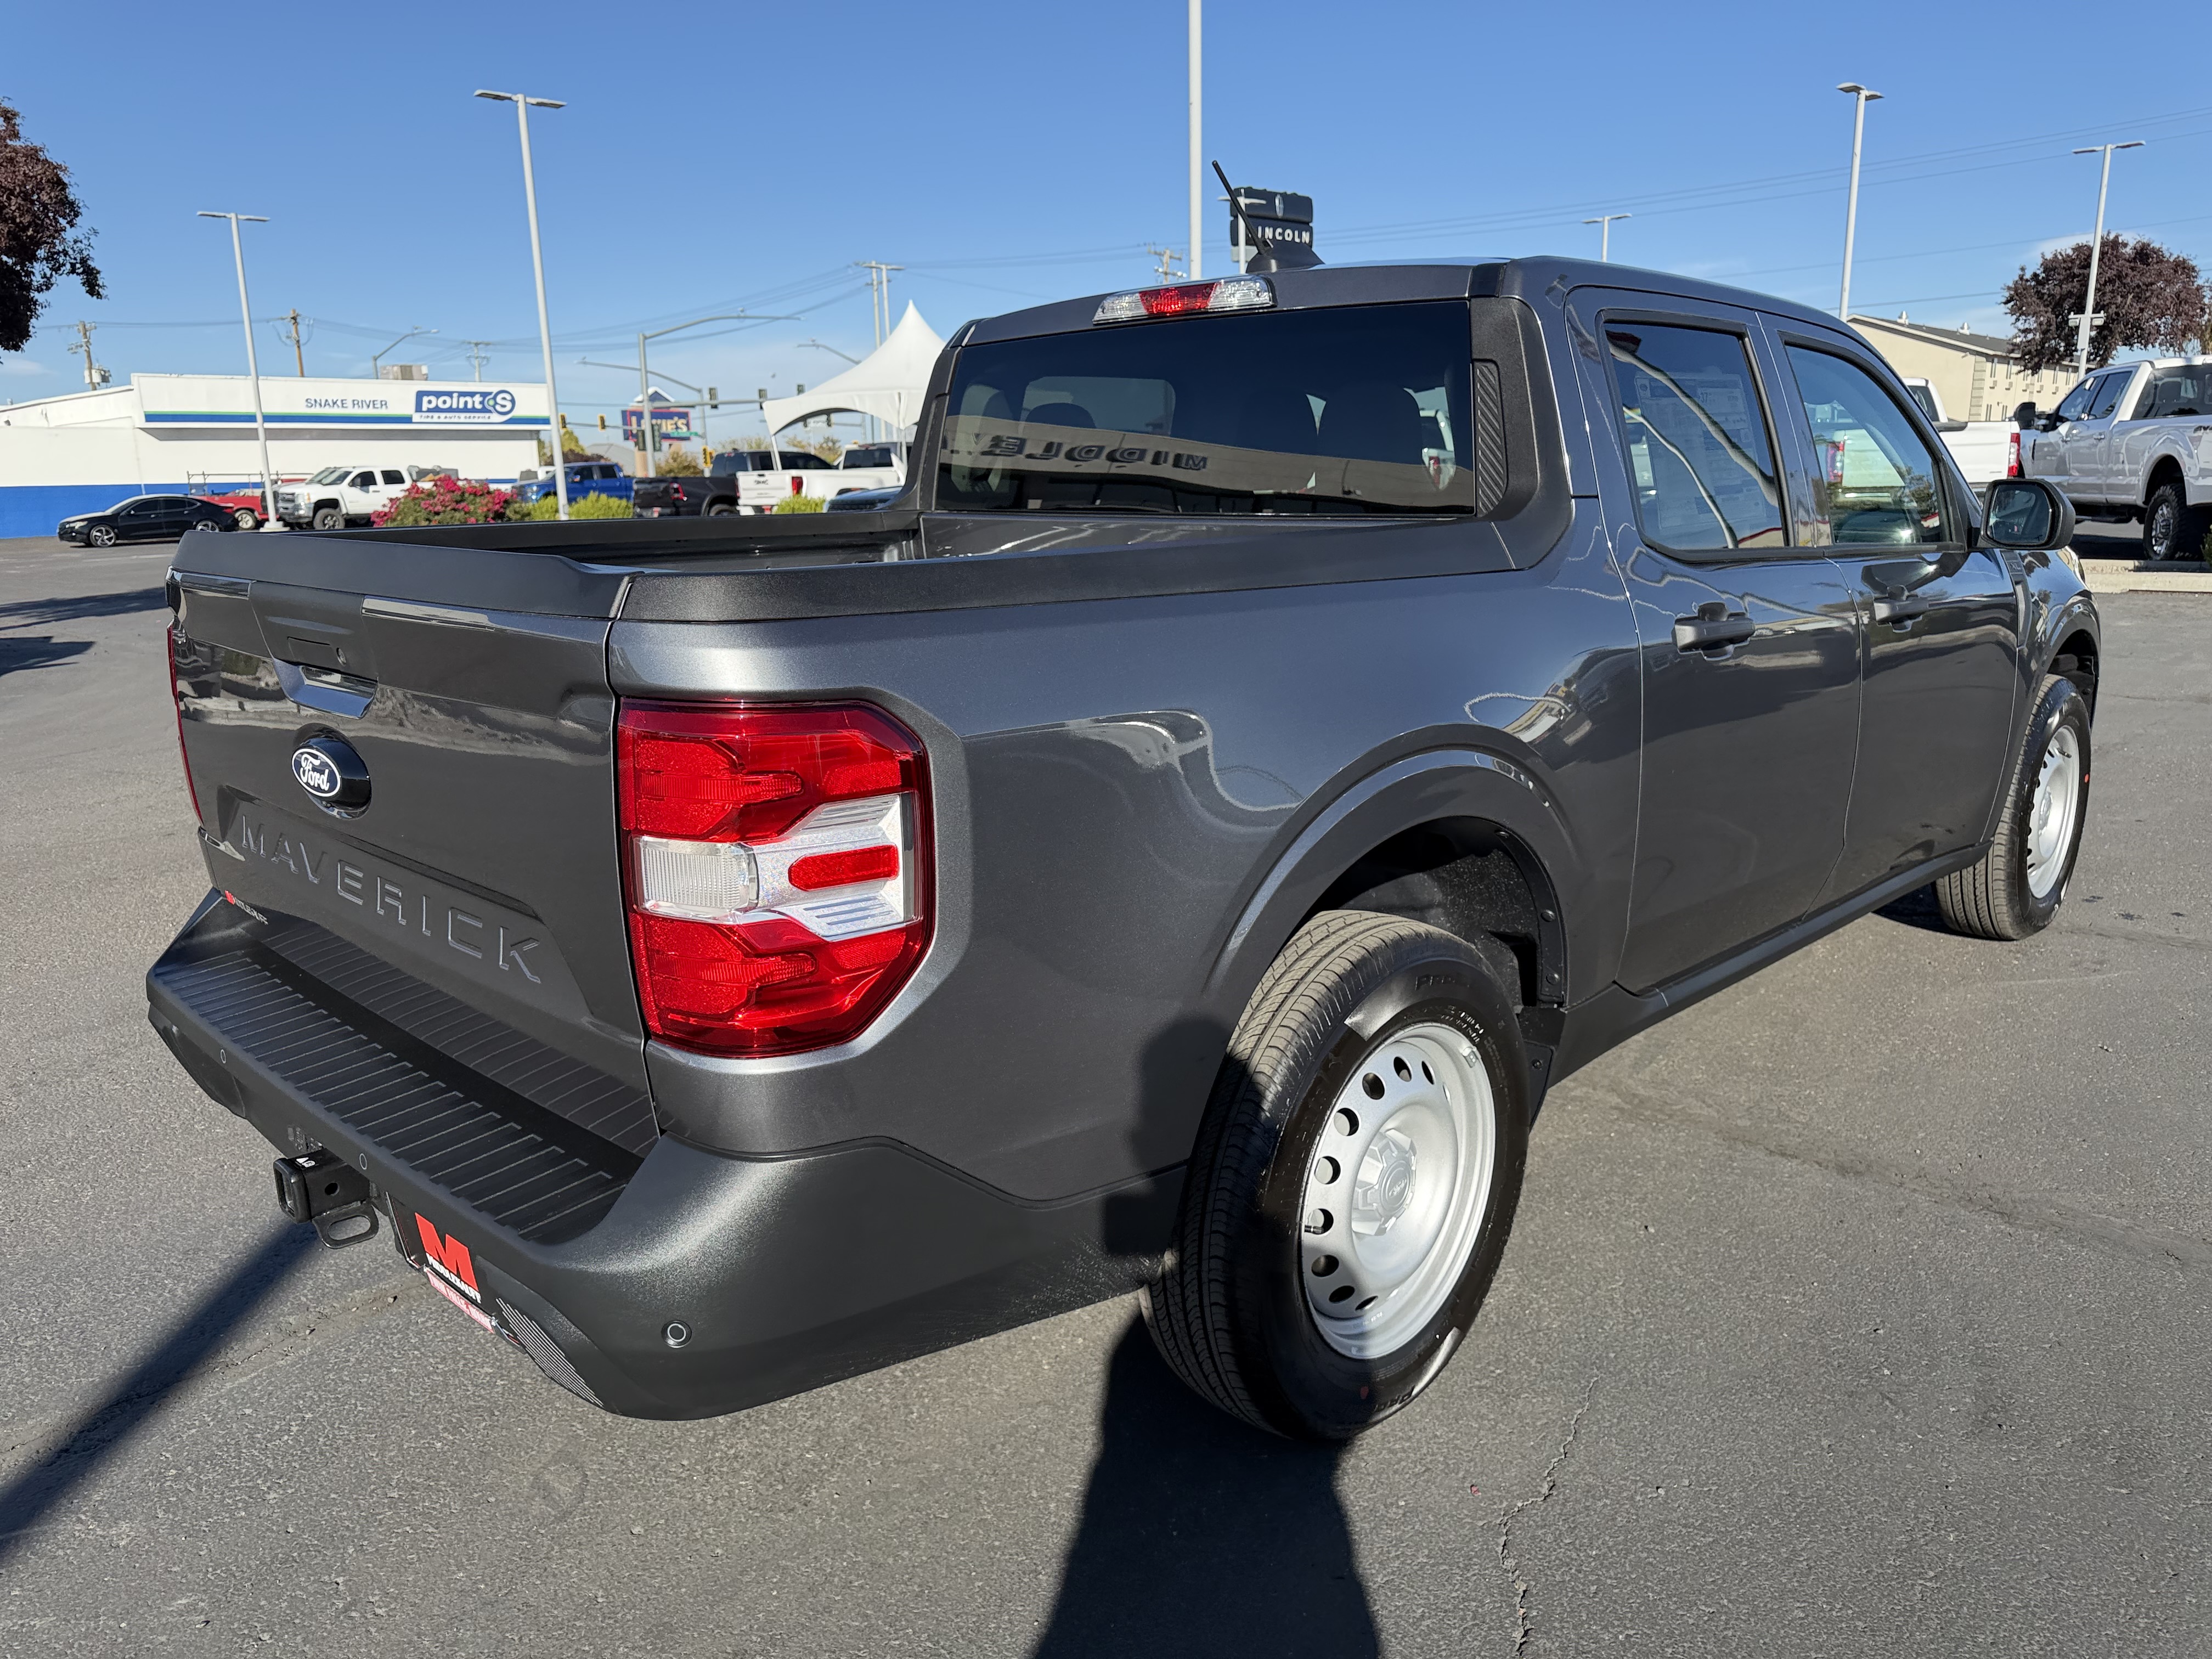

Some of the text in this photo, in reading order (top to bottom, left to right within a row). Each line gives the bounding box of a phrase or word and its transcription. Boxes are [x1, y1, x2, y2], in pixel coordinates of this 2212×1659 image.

[1249, 225, 1310, 244] INCOLN
[305, 398, 388, 409] SNAKE RIVER
[422, 393, 483, 411] point
[300, 753, 330, 791] Ford
[240, 815, 542, 984] MAVERICK
